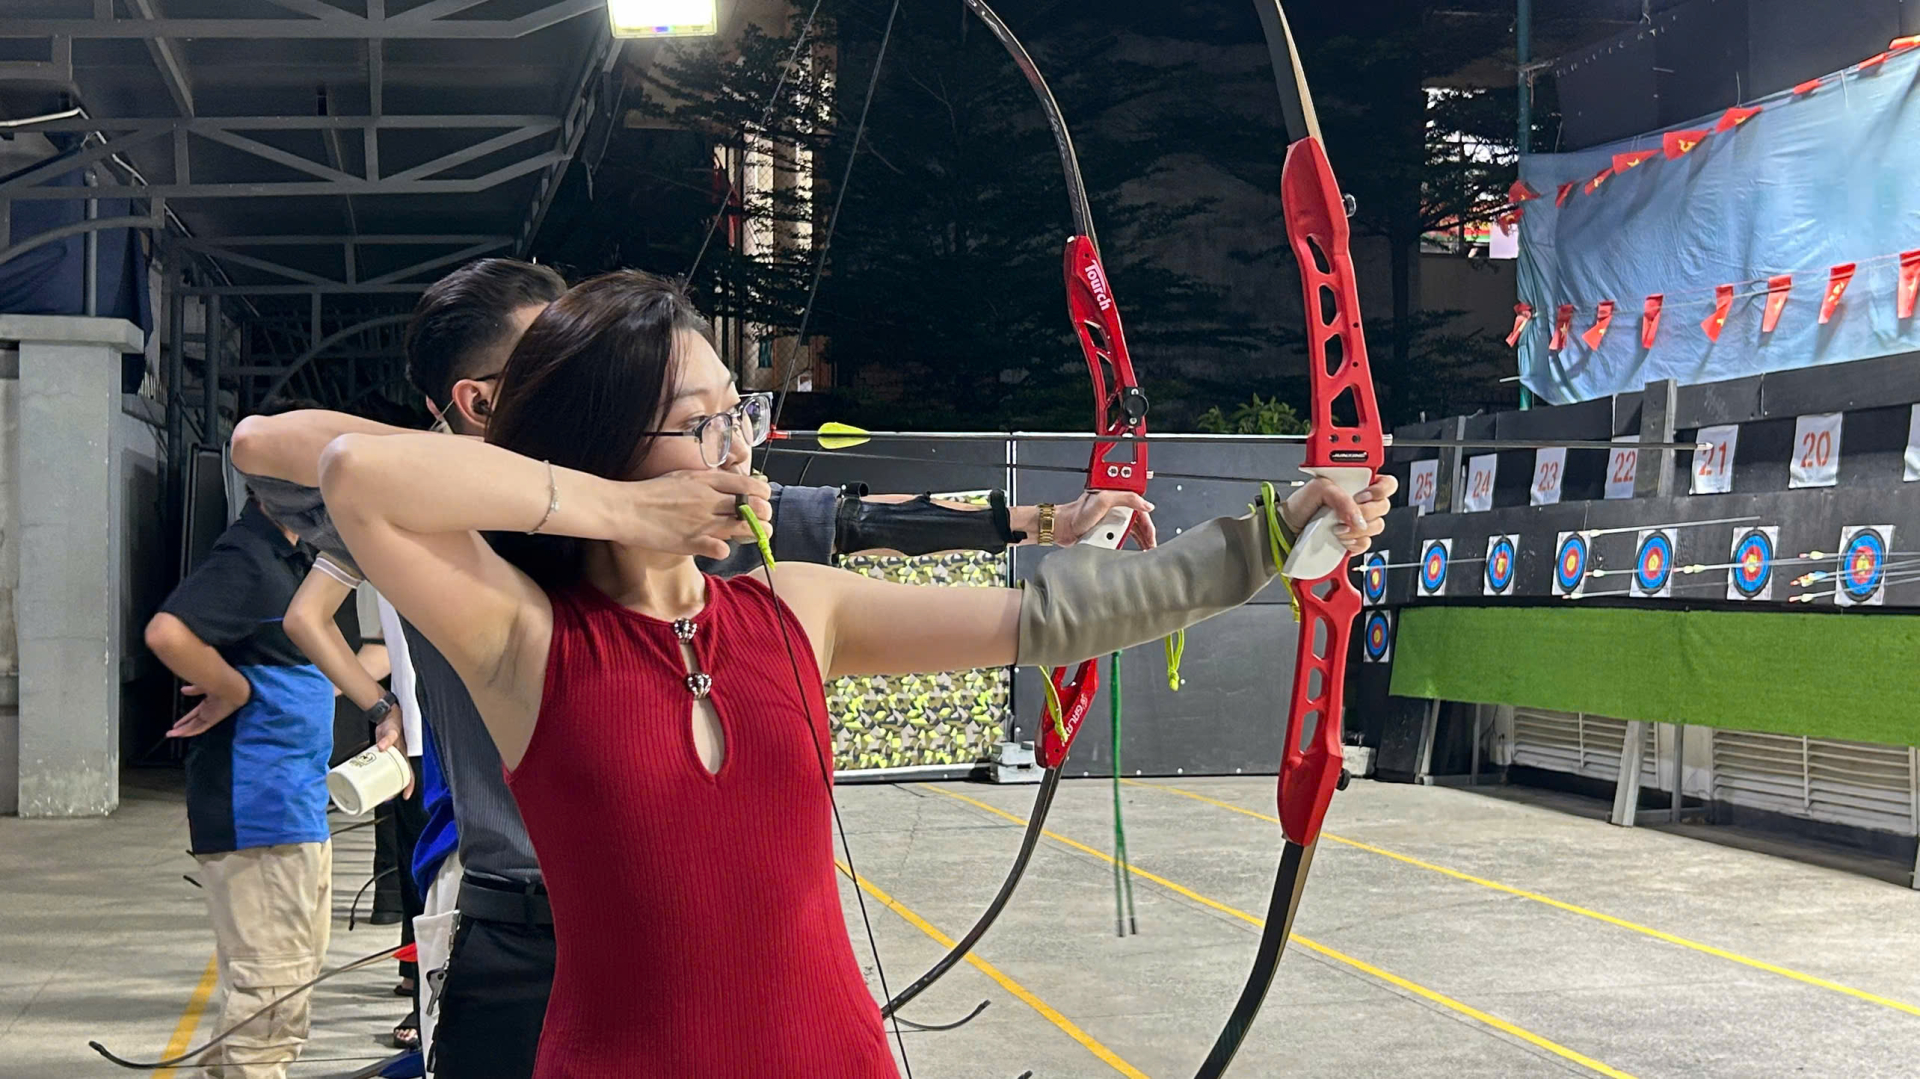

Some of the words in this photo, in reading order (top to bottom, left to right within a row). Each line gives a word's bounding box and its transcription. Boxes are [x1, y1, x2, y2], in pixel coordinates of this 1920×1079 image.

[1084, 259, 1112, 311] Tourch
[1699, 441, 1727, 476] 21
[1799, 430, 1831, 468] 20
[1472, 470, 1491, 498] 24
[1537, 461, 1559, 492] 23
[1612, 450, 1637, 484] 22
[1414, 471, 1433, 500] 25
[1062, 704, 1084, 744] GALA
